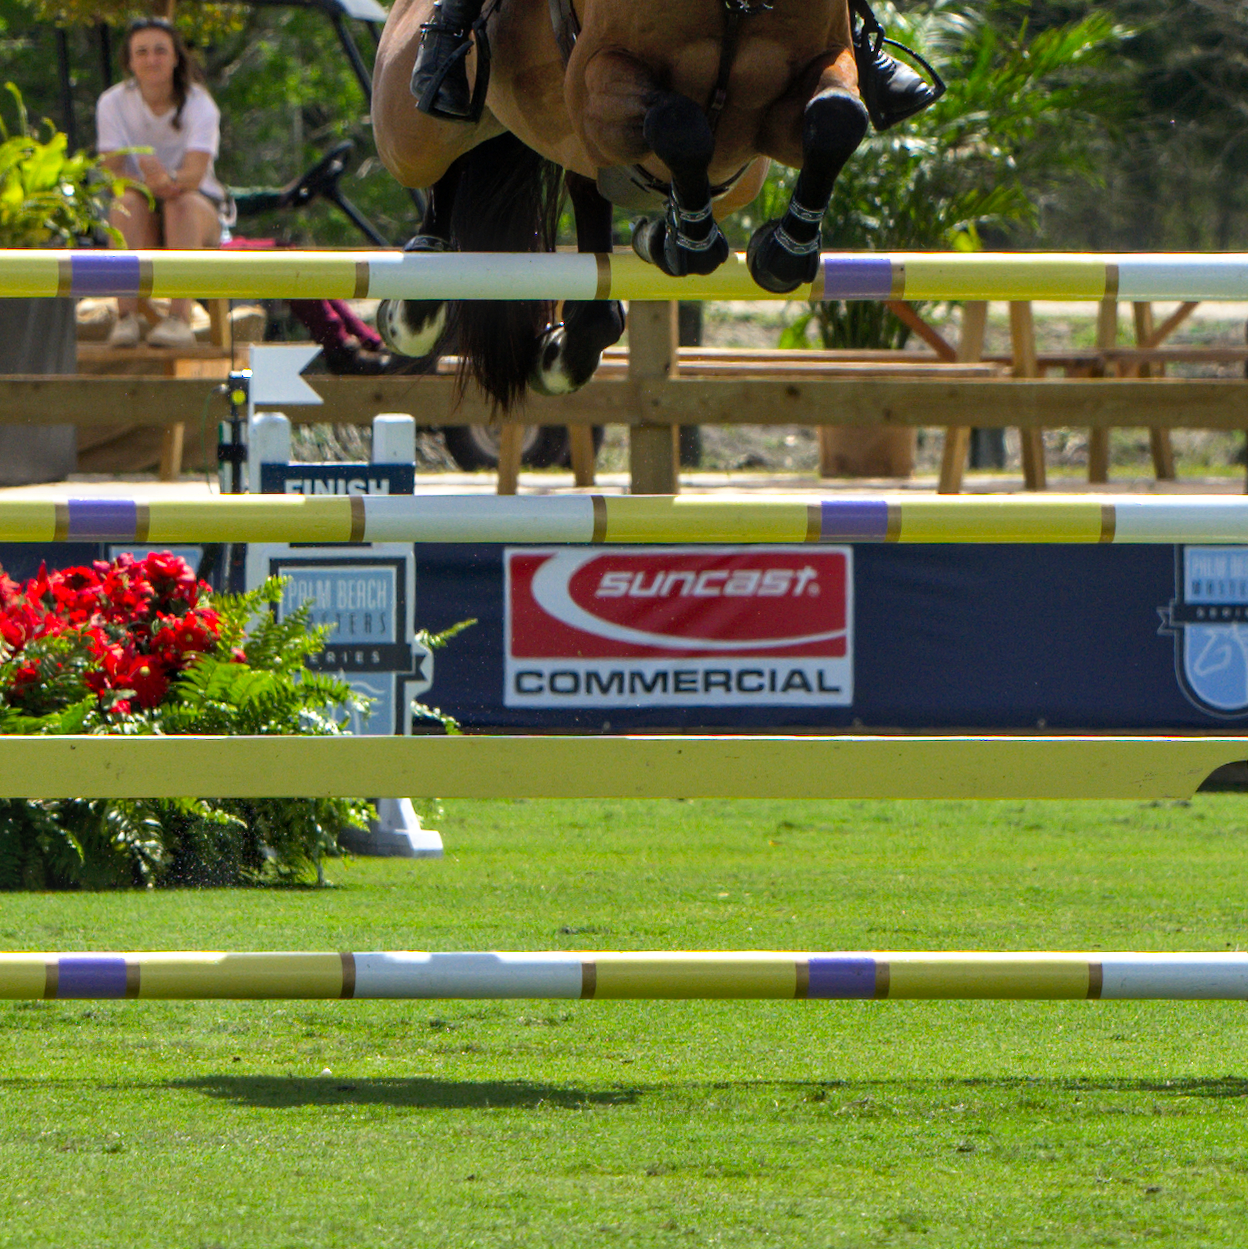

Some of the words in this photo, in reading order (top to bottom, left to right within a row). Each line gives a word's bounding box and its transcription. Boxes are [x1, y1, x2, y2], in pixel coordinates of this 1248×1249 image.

[284, 478, 390, 495] FINISH
[288, 579, 332, 610] PALM
[337, 578, 387, 610] BEACH
[305, 612, 386, 635] ATERS
[309, 651, 380, 664] ERIES
[514, 668, 842, 695] COMMERCIAL
